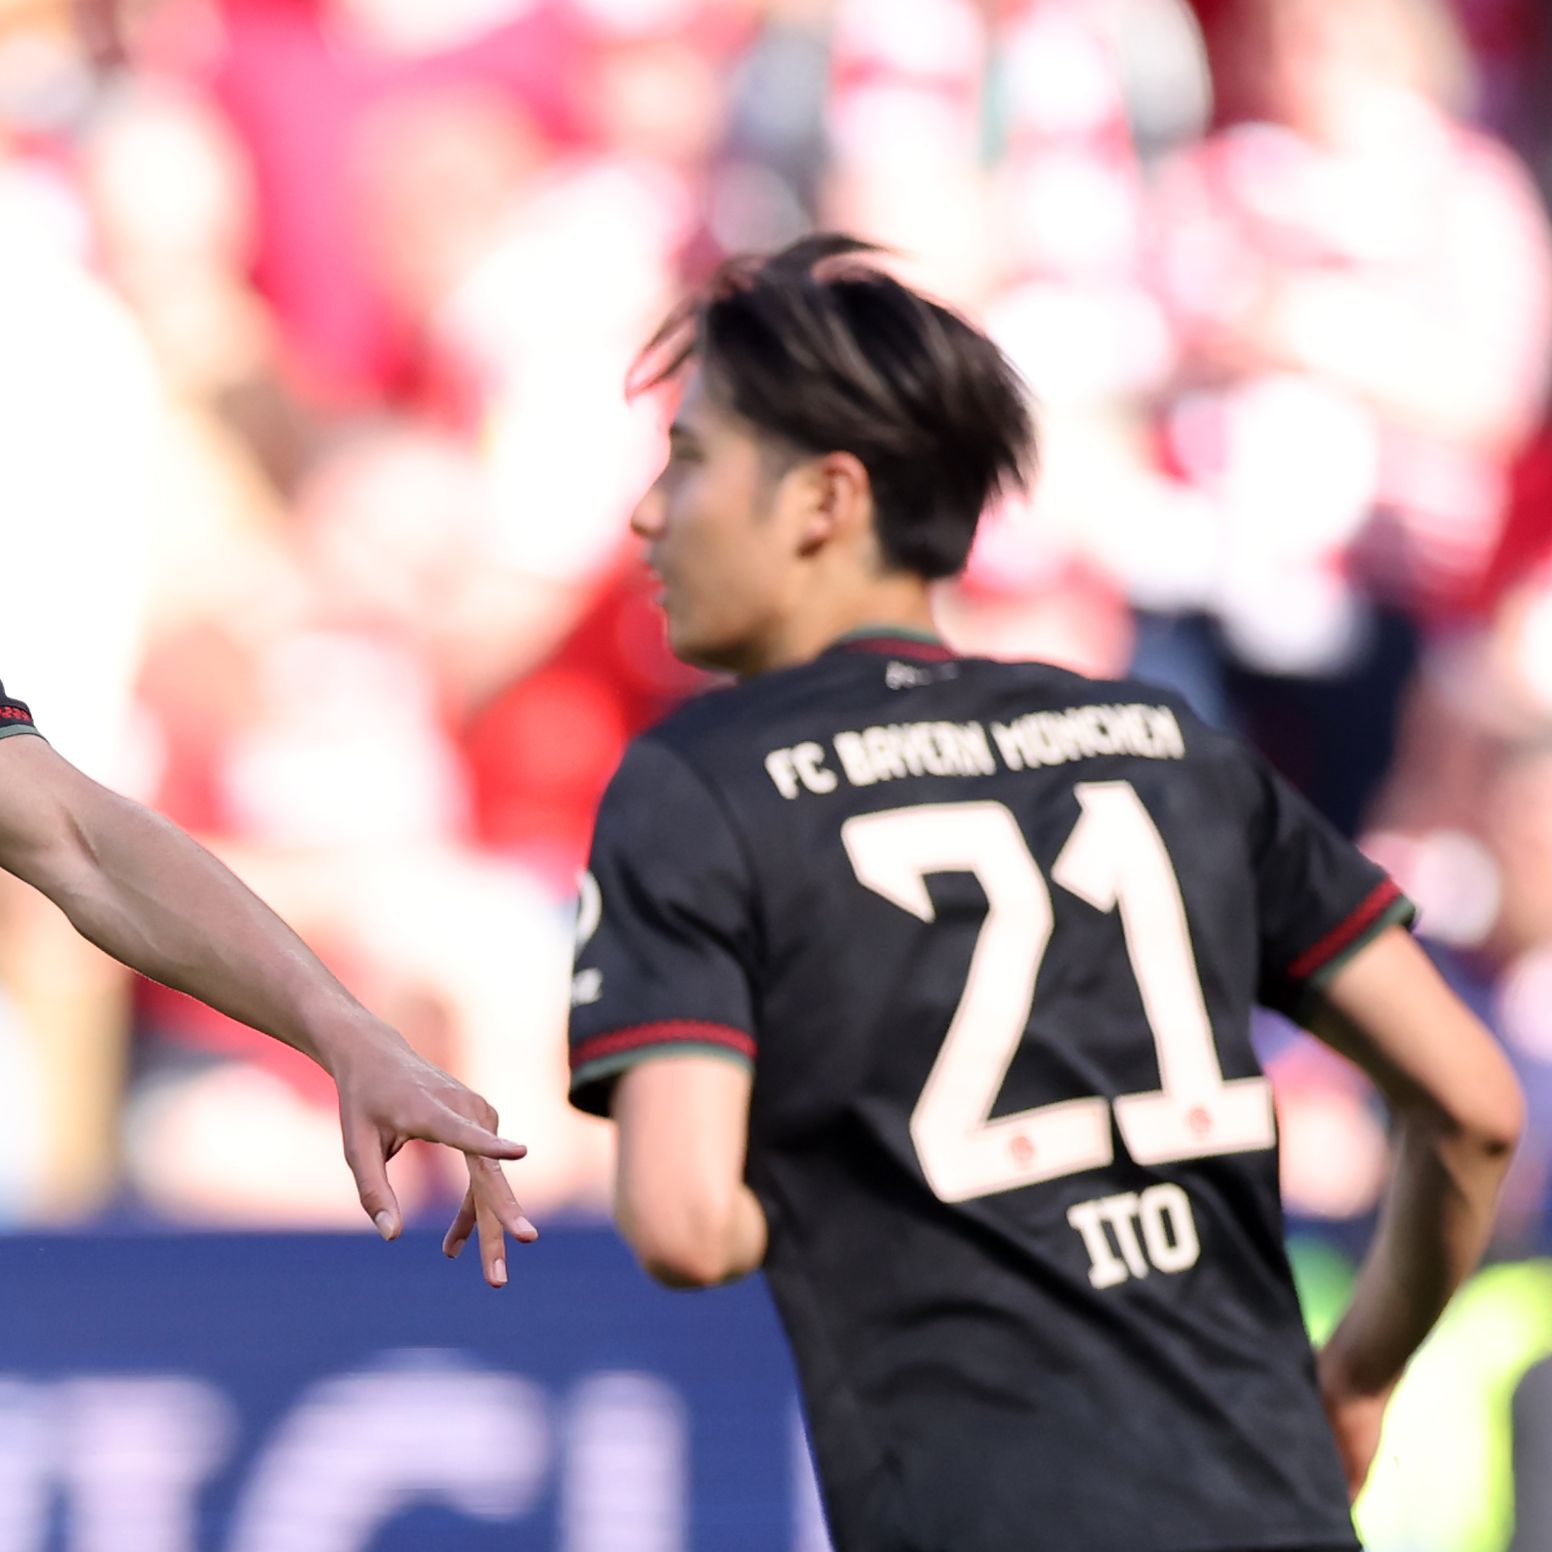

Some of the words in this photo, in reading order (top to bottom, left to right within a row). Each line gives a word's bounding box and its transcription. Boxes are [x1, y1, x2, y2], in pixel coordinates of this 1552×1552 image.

[765, 741, 838, 799] FC
[833, 721, 997, 787] BAYERN
[840, 780, 1276, 1204] 21
[1066, 1182, 1201, 1290] ITO
